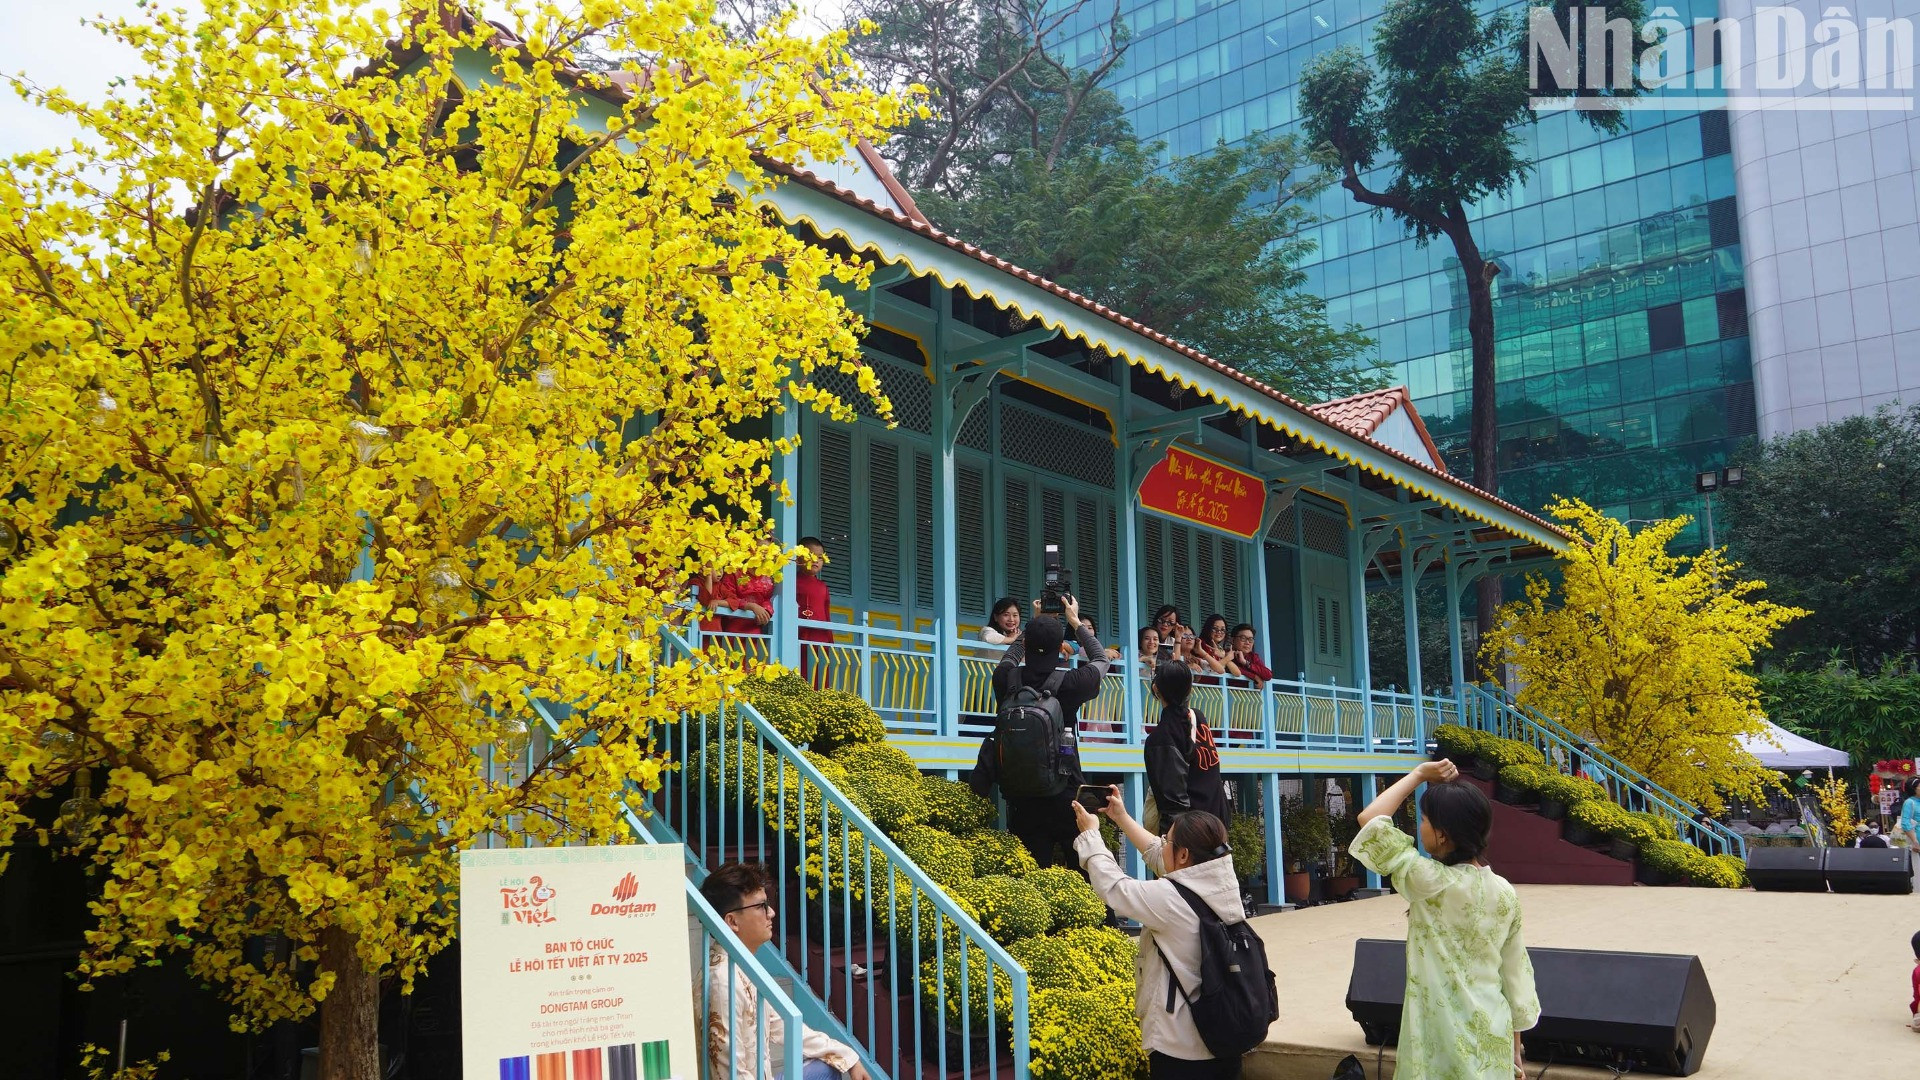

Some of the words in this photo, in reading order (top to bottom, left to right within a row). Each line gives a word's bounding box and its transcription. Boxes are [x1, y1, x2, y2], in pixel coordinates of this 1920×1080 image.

[1206, 500, 1230, 523] 2025
[500, 887, 530, 908] Tết
[513, 908, 557, 927] Việt
[590, 902, 657, 916] Dongtam
[545, 942, 567, 954] BAN
[586, 937, 614, 951] CHỨC
[524, 958, 544, 973] HỘI
[547, 955, 565, 970] TẾT
[568, 954, 589, 969] VIỆT
[623, 952, 648, 964] 2025
[540, 1001, 588, 1015] DONGTAM
[591, 997, 624, 1010] GROUP
